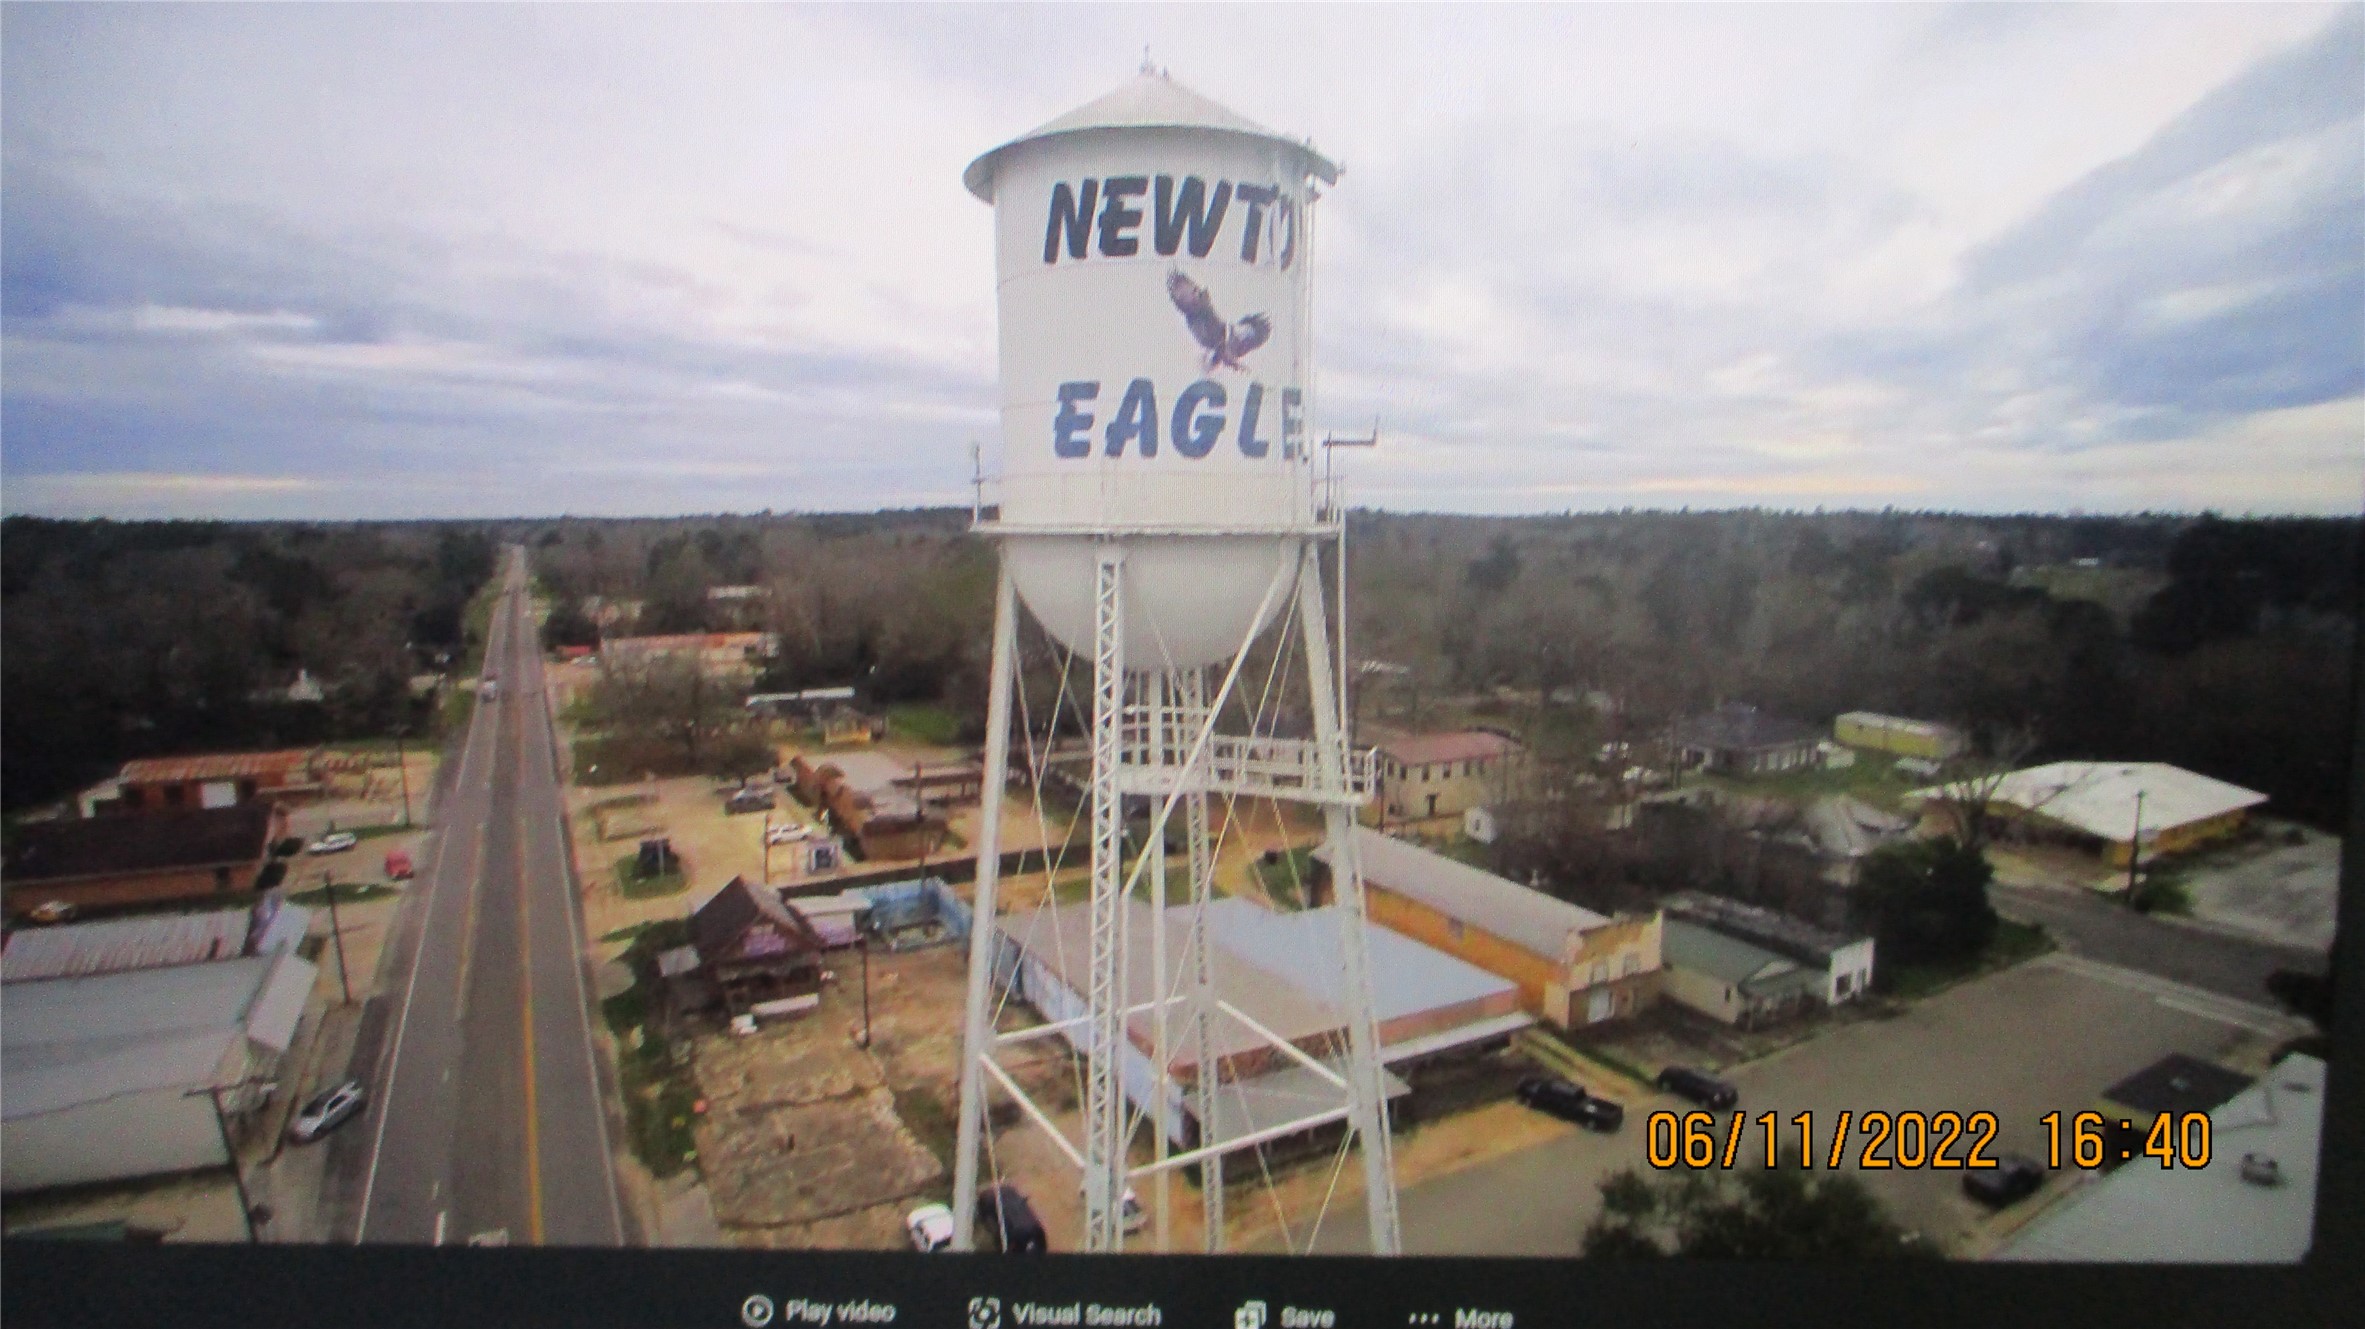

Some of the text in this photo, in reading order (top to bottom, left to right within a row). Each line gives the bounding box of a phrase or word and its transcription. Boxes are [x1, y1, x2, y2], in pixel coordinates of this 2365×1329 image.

[1054, 377, 1303, 460] EAGLE
[786, 1298, 897, 1327] Play video
[1012, 1302, 1162, 1327] Visual Search
[1281, 1306, 1335, 1328] Save
[1455, 1307, 1513, 1329] More
